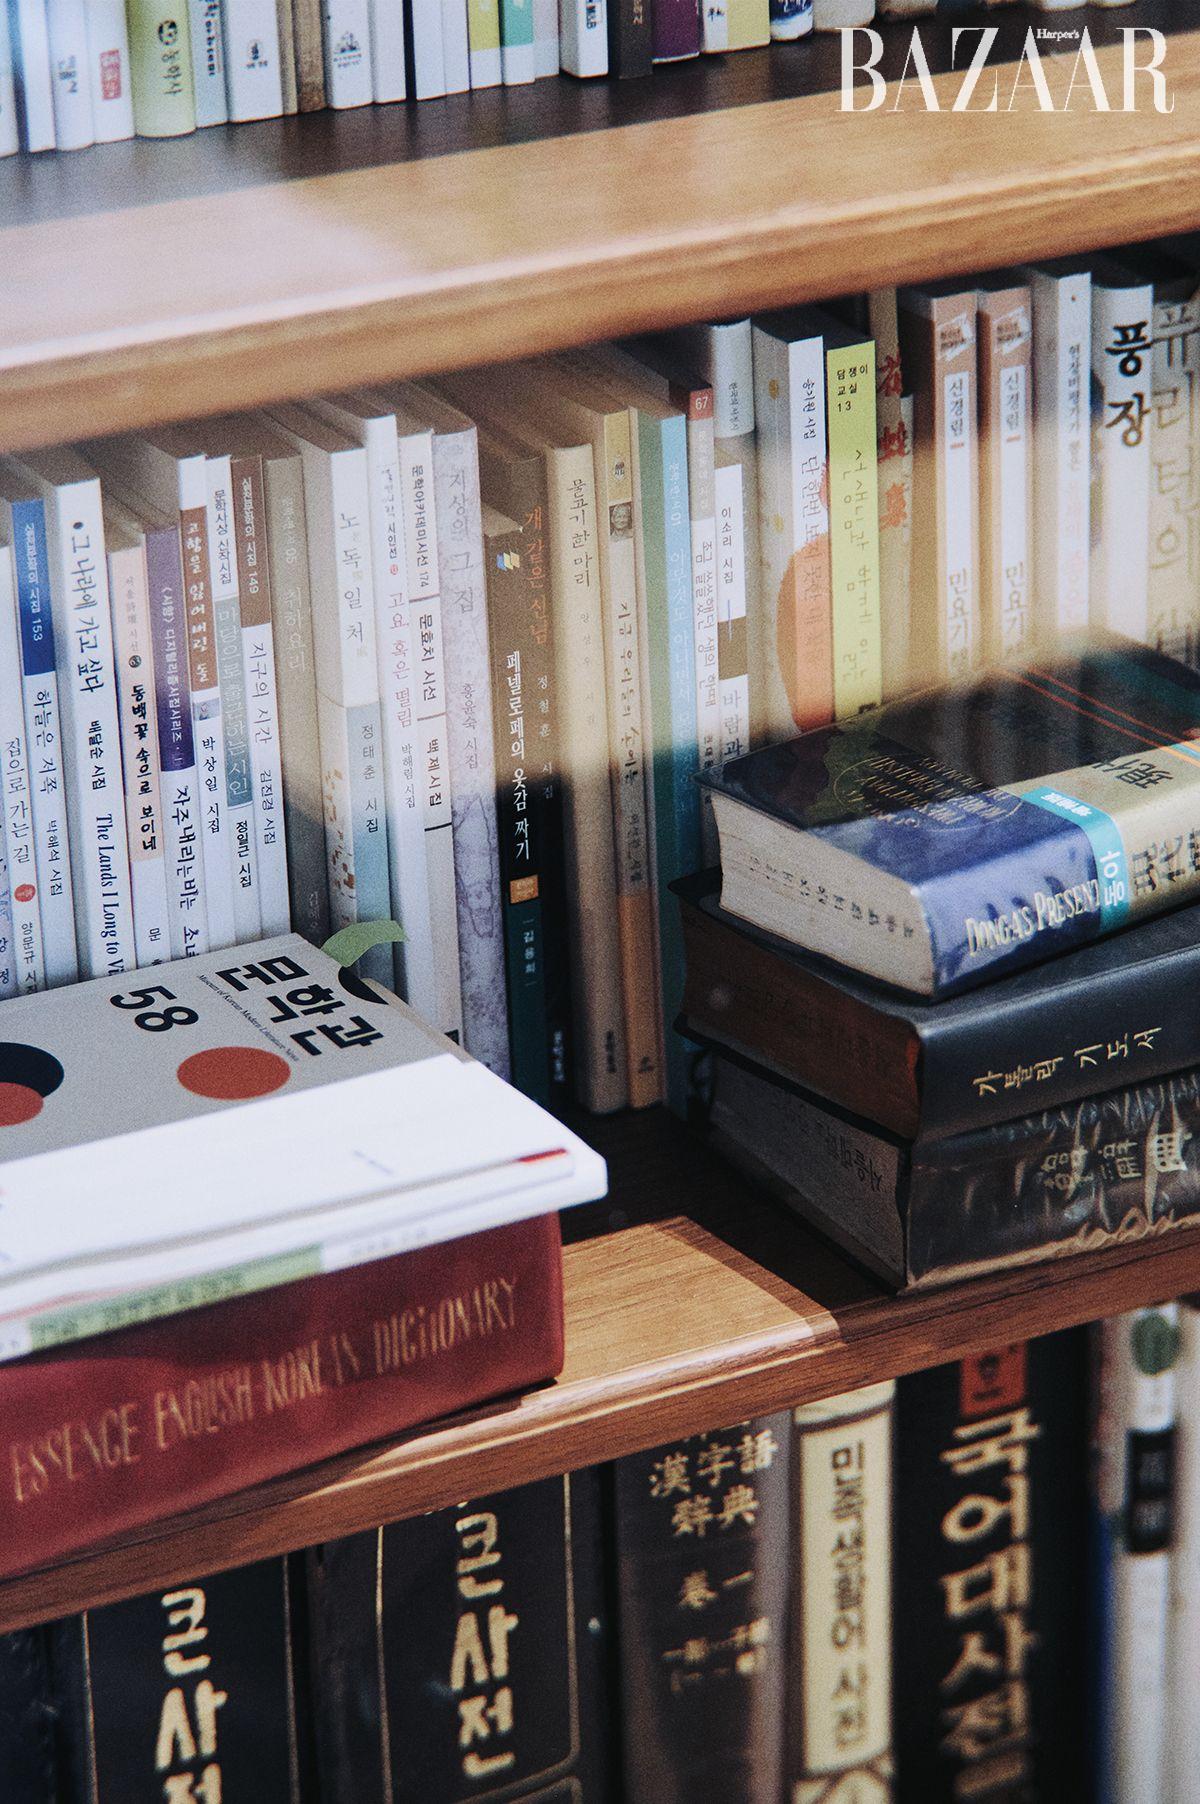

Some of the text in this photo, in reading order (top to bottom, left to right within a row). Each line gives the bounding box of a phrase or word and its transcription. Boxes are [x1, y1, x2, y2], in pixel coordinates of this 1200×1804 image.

[837, 365, 868, 381] 담쟁이
[837, 383, 858, 397] 교실
[1103, 320, 1150, 449] 풍장
[801, 378, 818, 441] 송기원 시집
[949, 376, 965, 438] 신경림
[411, 464, 427, 567] 문학아카데미시선
[566, 478, 593, 588] 물고기 한 마리
[721, 507, 736, 585] 이소리 시집
[696, 540, 714, 563] 조금
[33, 618, 44, 642] 153
[70, 535, 105, 693] 그 나라에 가고 싶다
[391, 591, 412, 729] 고요 혹은 떨림
[418, 613, 439, 704] 문효치 시선
[698, 637, 718, 667] 생의
[131, 683, 148, 741] 동백꽃
[249, 641, 273, 746] 지구의 시간
[507, 651, 525, 761] 페넬로페의
[700, 674, 719, 708] 한때
[33, 690, 58, 795] 하늘은 저쪽
[87, 719, 108, 791] 배달순 시집
[463, 737, 479, 770] 시집
[722, 690, 744, 757] 바람과
[202, 735, 221, 834] 박상일 시집
[229, 757, 249, 799] 시인
[360, 723, 379, 834] 정태춘 시집
[401, 742, 417, 809] 박해림 시집
[512, 767, 528, 812] 옷감
[9, 800, 31, 839] 가는
[96, 812, 114, 841] The
[139, 804, 159, 852] 보이네
[259, 769, 278, 846] 김진경 시집
[515, 817, 530, 861] 짜기
[14, 844, 32, 864] 길
[45, 819, 64, 897] 박해석 시집
[97, 845, 118, 888] Lands
[171, 785, 200, 911] 자주내리는비는
[238, 861, 253, 890] 시집
[100, 903, 120, 939] Long
[1034, 875, 1102, 931] PRESENT
[105, 942, 120, 955] to
[109, 984, 200, 1033] 58
[195, 974, 221, 991] Museum
[220, 994, 245, 1011] Korean
[238, 1010, 265, 1027] Modern
[214, 955, 385, 1057] 문학관
[972, 1027, 1162, 1097] 가톨릭 기도서
[649, 1430, 780, 1499] 漢字語
[940, 1408, 1043, 1798] 국어대사전
[450, 1512, 519, 1780] 큰사전
